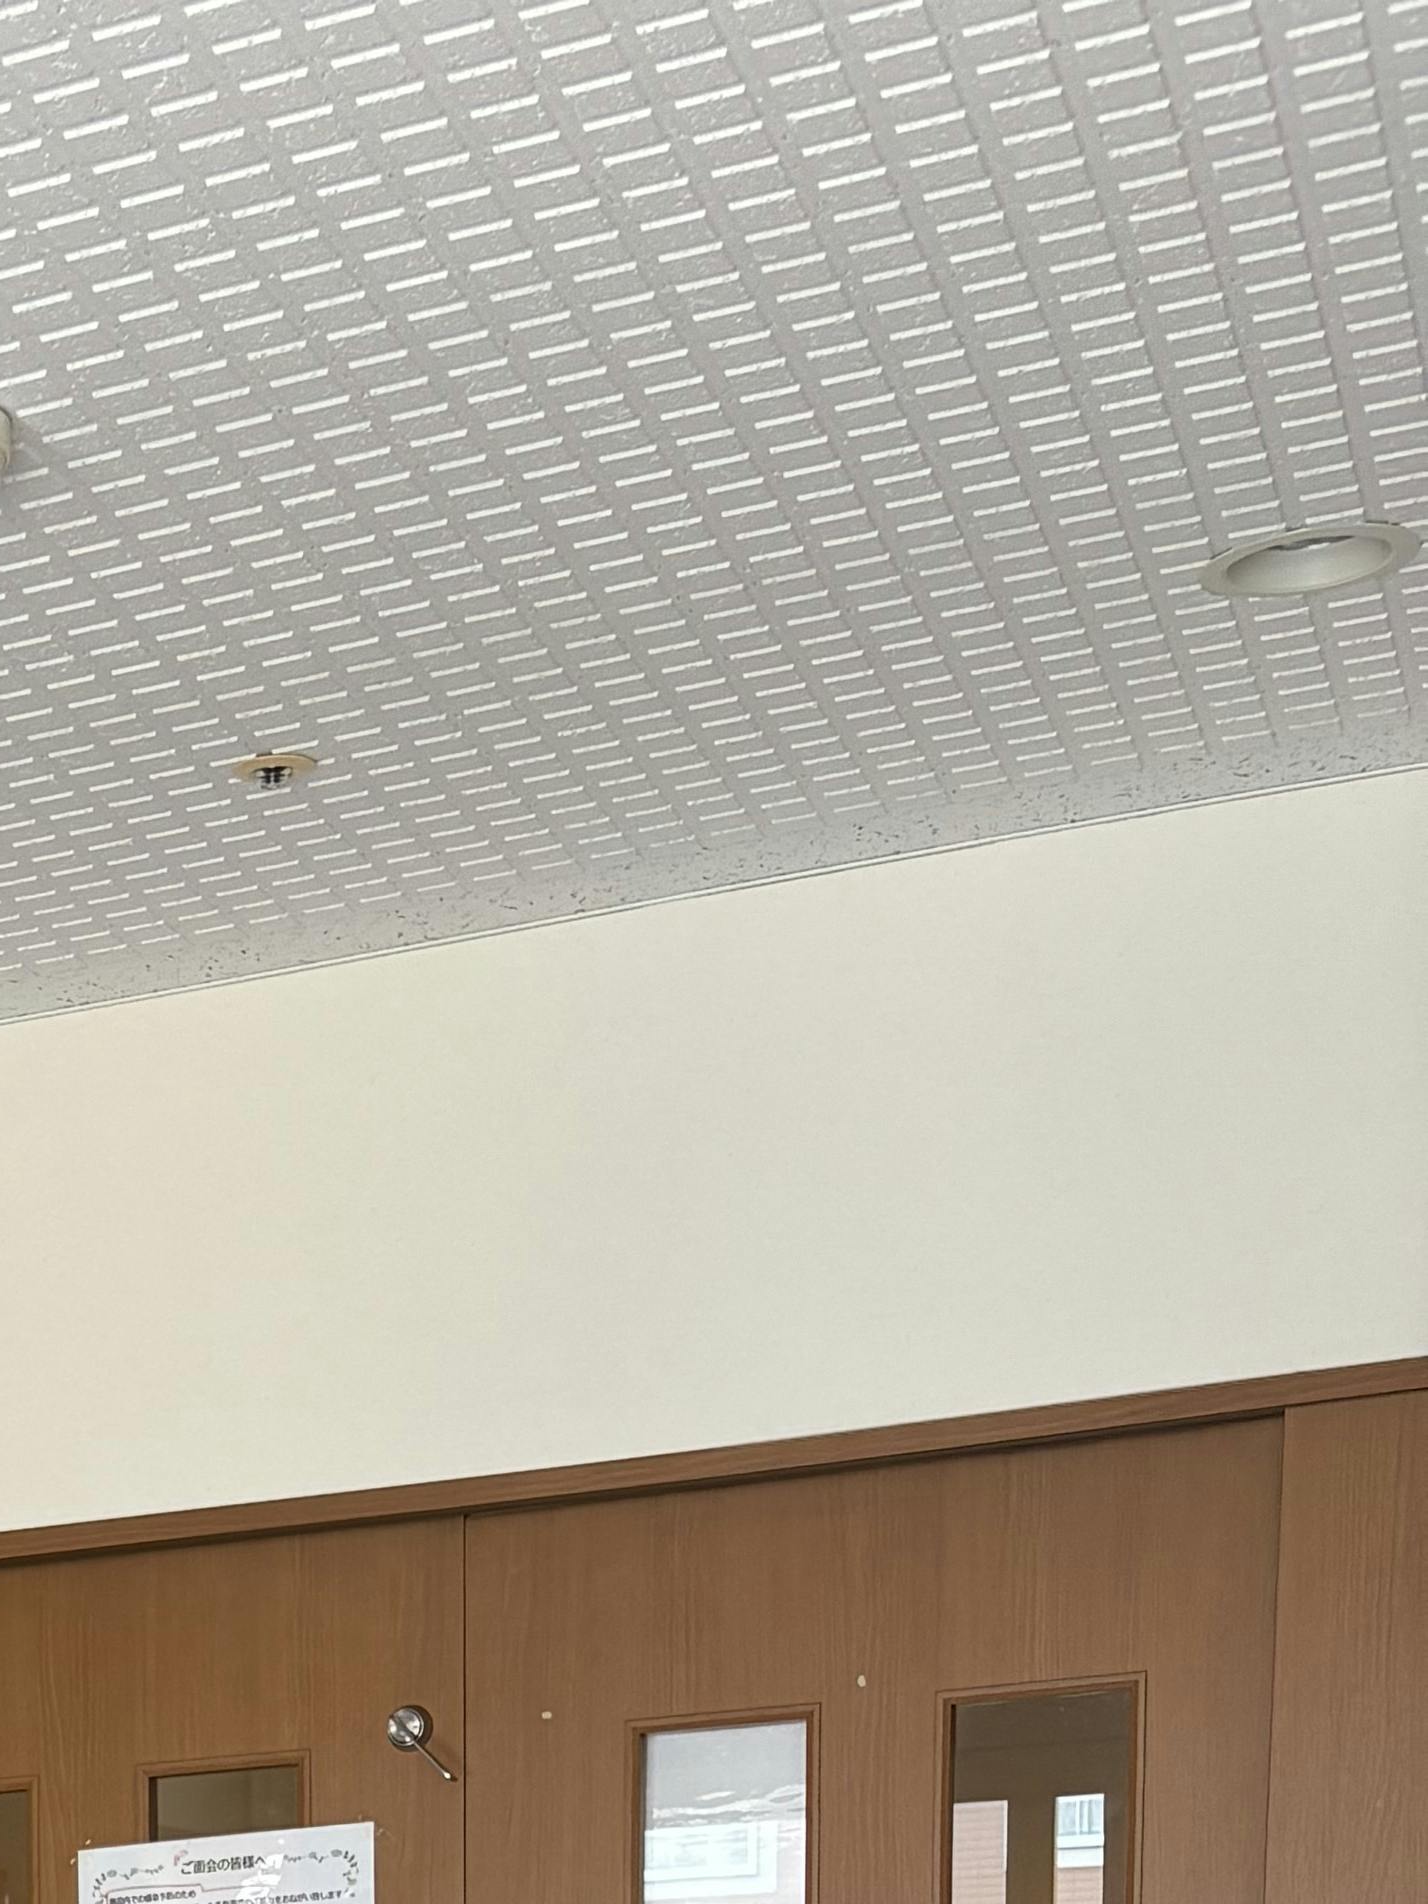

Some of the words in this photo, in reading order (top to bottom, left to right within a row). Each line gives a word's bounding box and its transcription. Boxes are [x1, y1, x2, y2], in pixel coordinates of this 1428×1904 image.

[181, 1855, 265, 1875] ご面会の皆様へ
